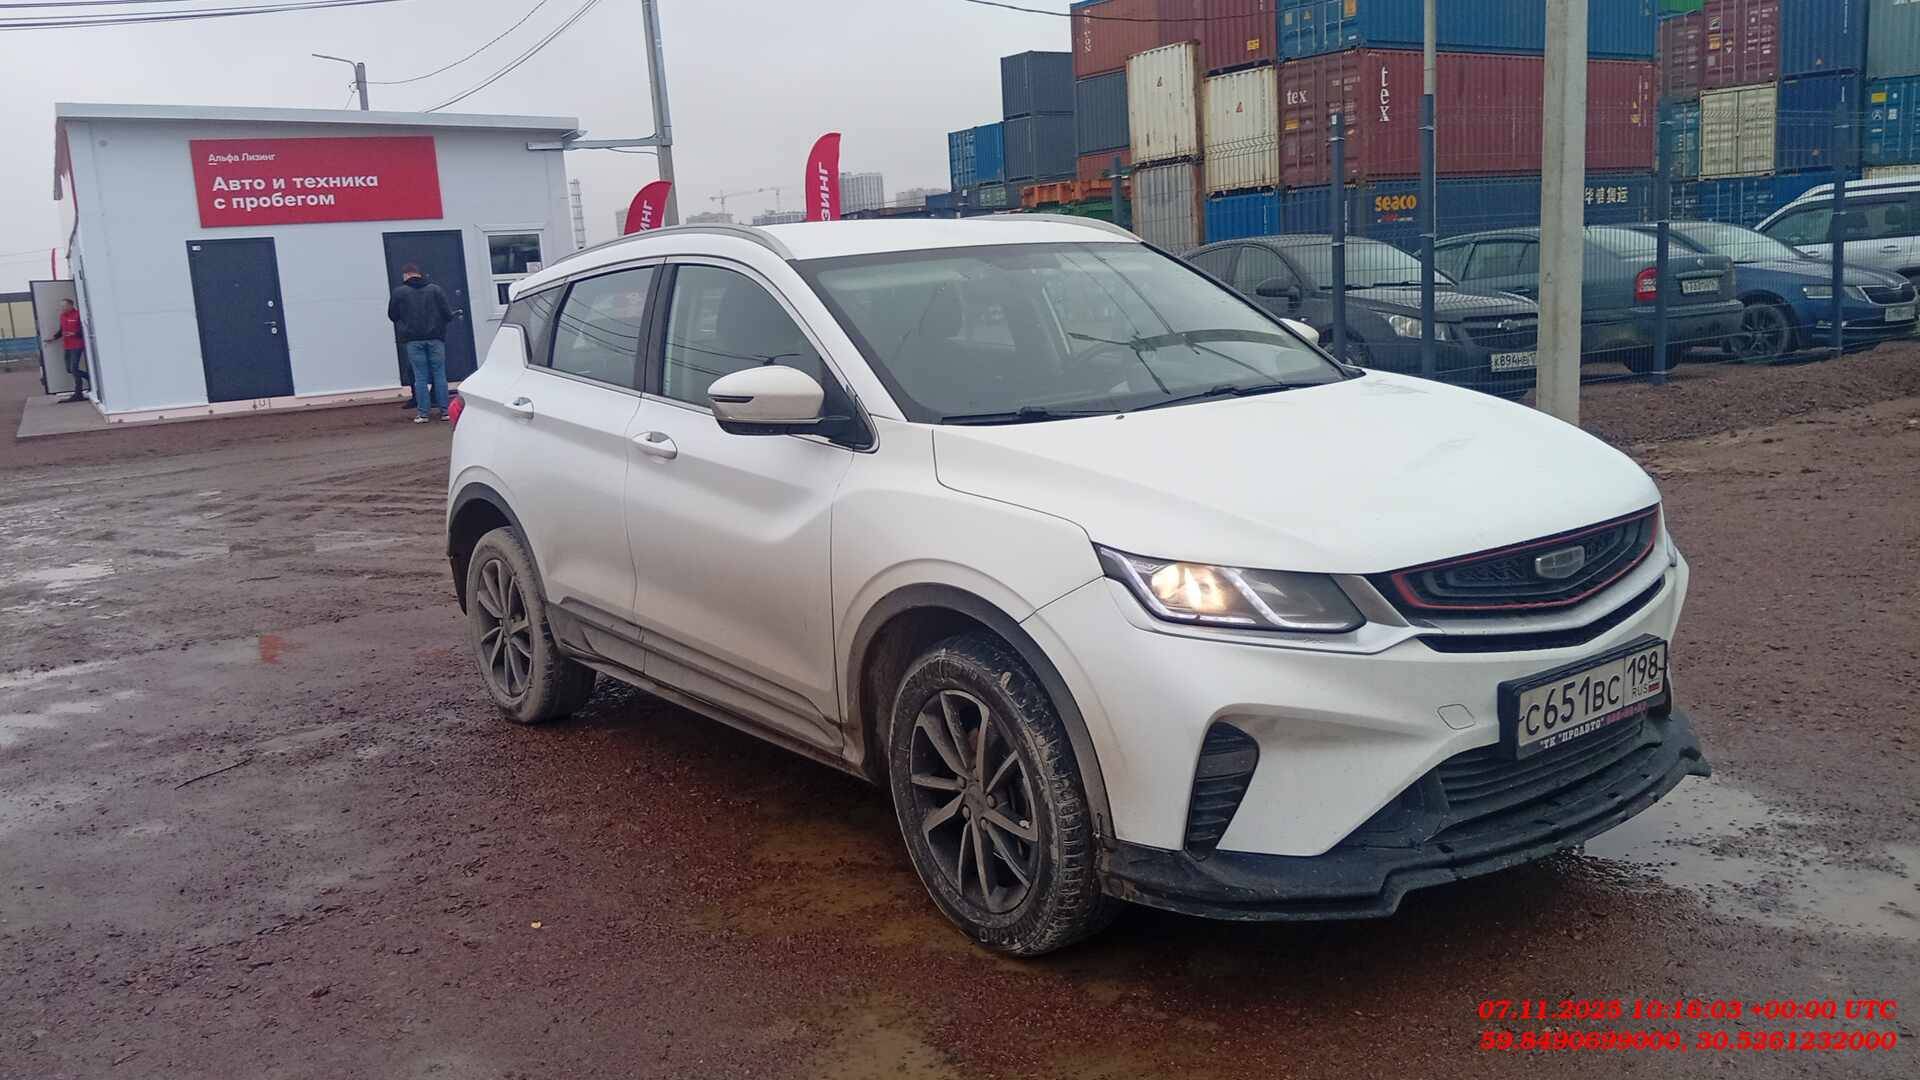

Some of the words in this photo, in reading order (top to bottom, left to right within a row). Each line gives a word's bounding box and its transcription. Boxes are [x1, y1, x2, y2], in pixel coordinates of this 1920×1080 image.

[1286, 89, 1308, 105] tex
[1380, 66, 1390, 122] tex
[208, 153, 239, 164] Альфа
[241, 152, 276, 161] Лизинг
[212, 176, 266, 191] Авто
[272, 177, 286, 190] и
[292, 175, 379, 189] техника
[214, 197, 226, 210] с
[232, 193, 335, 211] пробегом
[1375, 194, 1417, 212] seaco
[1626, 650, 1659, 686] 198
[1632, 683, 1649, 698] RUS
